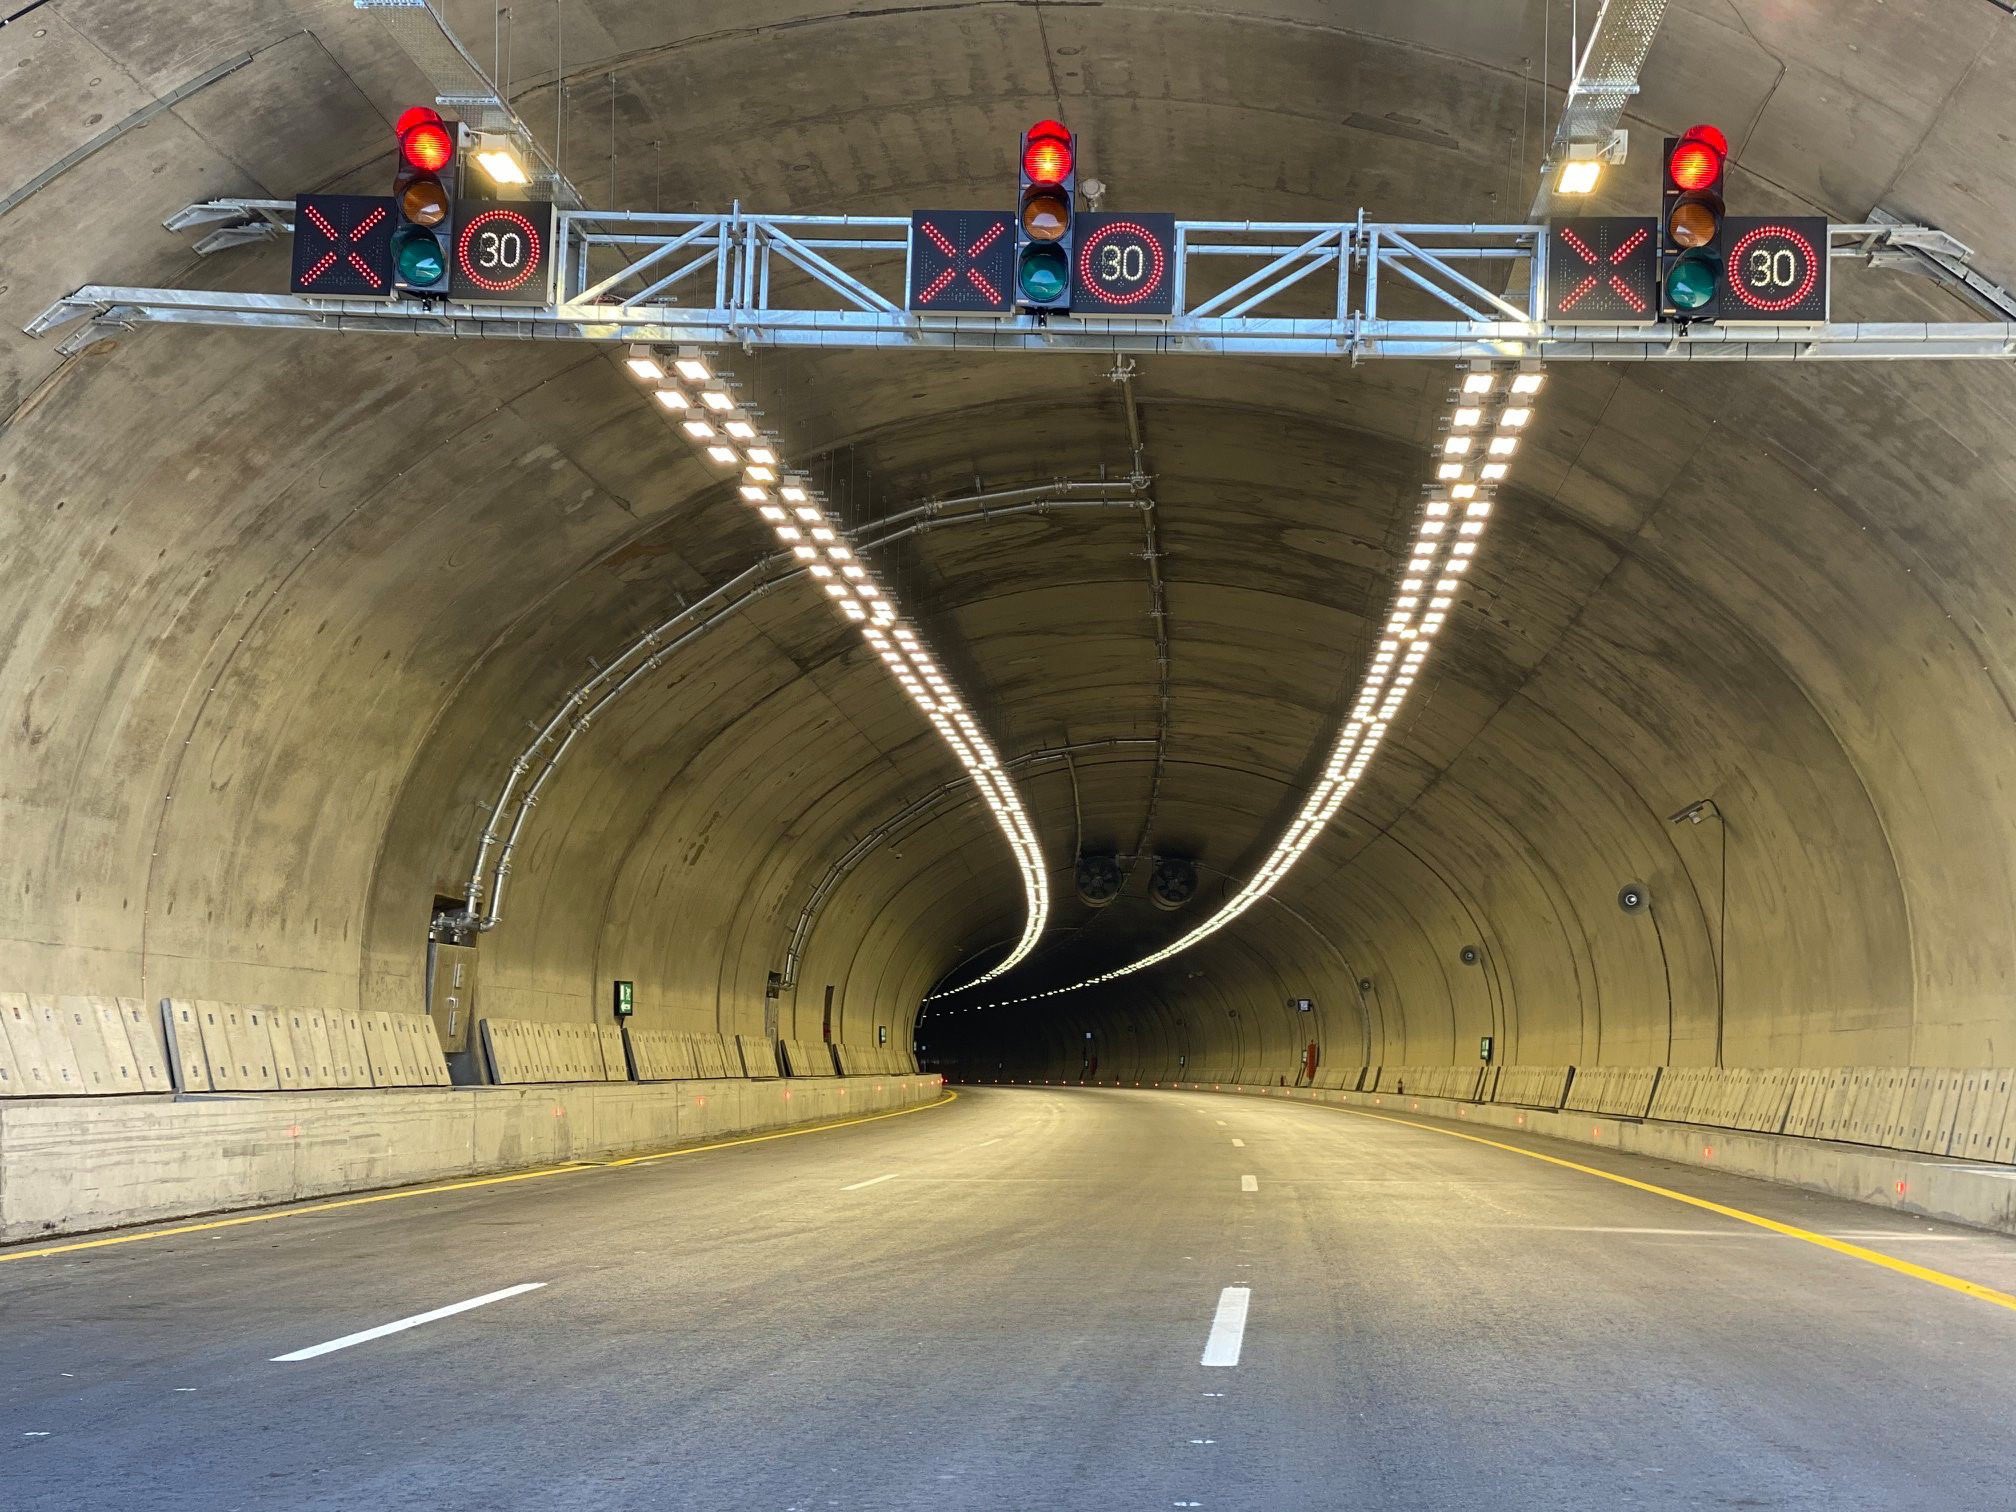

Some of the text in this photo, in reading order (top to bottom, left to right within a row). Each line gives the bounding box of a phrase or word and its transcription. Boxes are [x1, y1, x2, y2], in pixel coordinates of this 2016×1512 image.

[480, 232, 520, 268] 30
[1102, 245, 1143, 281] 30
[1750, 250, 1795, 286] 30
